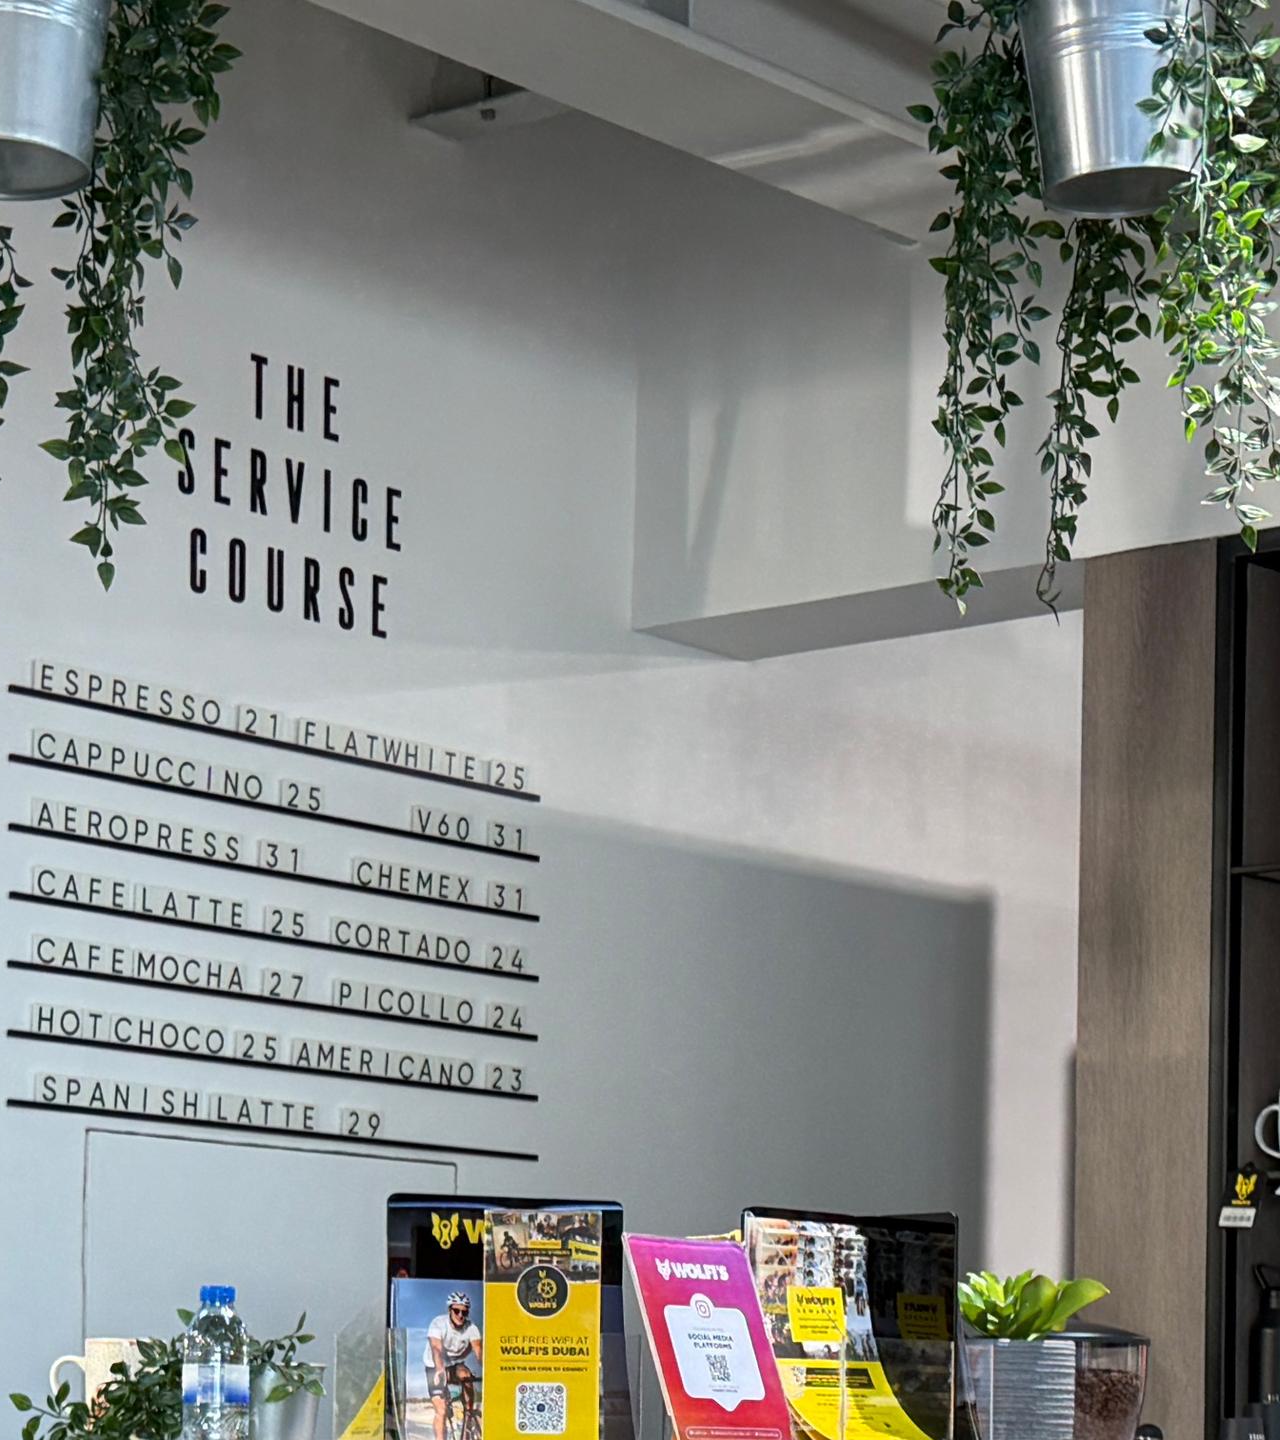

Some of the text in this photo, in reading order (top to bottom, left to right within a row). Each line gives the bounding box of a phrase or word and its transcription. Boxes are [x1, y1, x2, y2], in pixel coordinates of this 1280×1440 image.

[251, 353, 340, 442] THE
[178, 428, 402, 552] SERVICE
[190, 527, 388, 639] COURSE
[41, 664, 220, 725] ESPRESSO
[244, 709, 278, 738] 21
[495, 763, 525, 789] 25
[37, 733, 523, 850] CAPPUCCINO 25 V60 31
[37, 802, 523, 911] AEROPRESS 31 CHEMEX 31
[271, 910, 305, 937] 25
[335, 920, 471, 964] CORTADO
[492, 946, 524, 972] 24
[269, 972, 304, 999] 27
[339, 982, 473, 1024] PICOLLO
[492, 1006, 523, 1032] 24
[242, 1034, 276, 1061] 25
[296, 1042, 474, 1086] AMERICANO
[492, 1067, 523, 1092] 23
[348, 1111, 381, 1137] 29
[500, 1346, 590, 1357] WOLFI'S DUBAI
[522, 1336, 549, 1344] FREE
